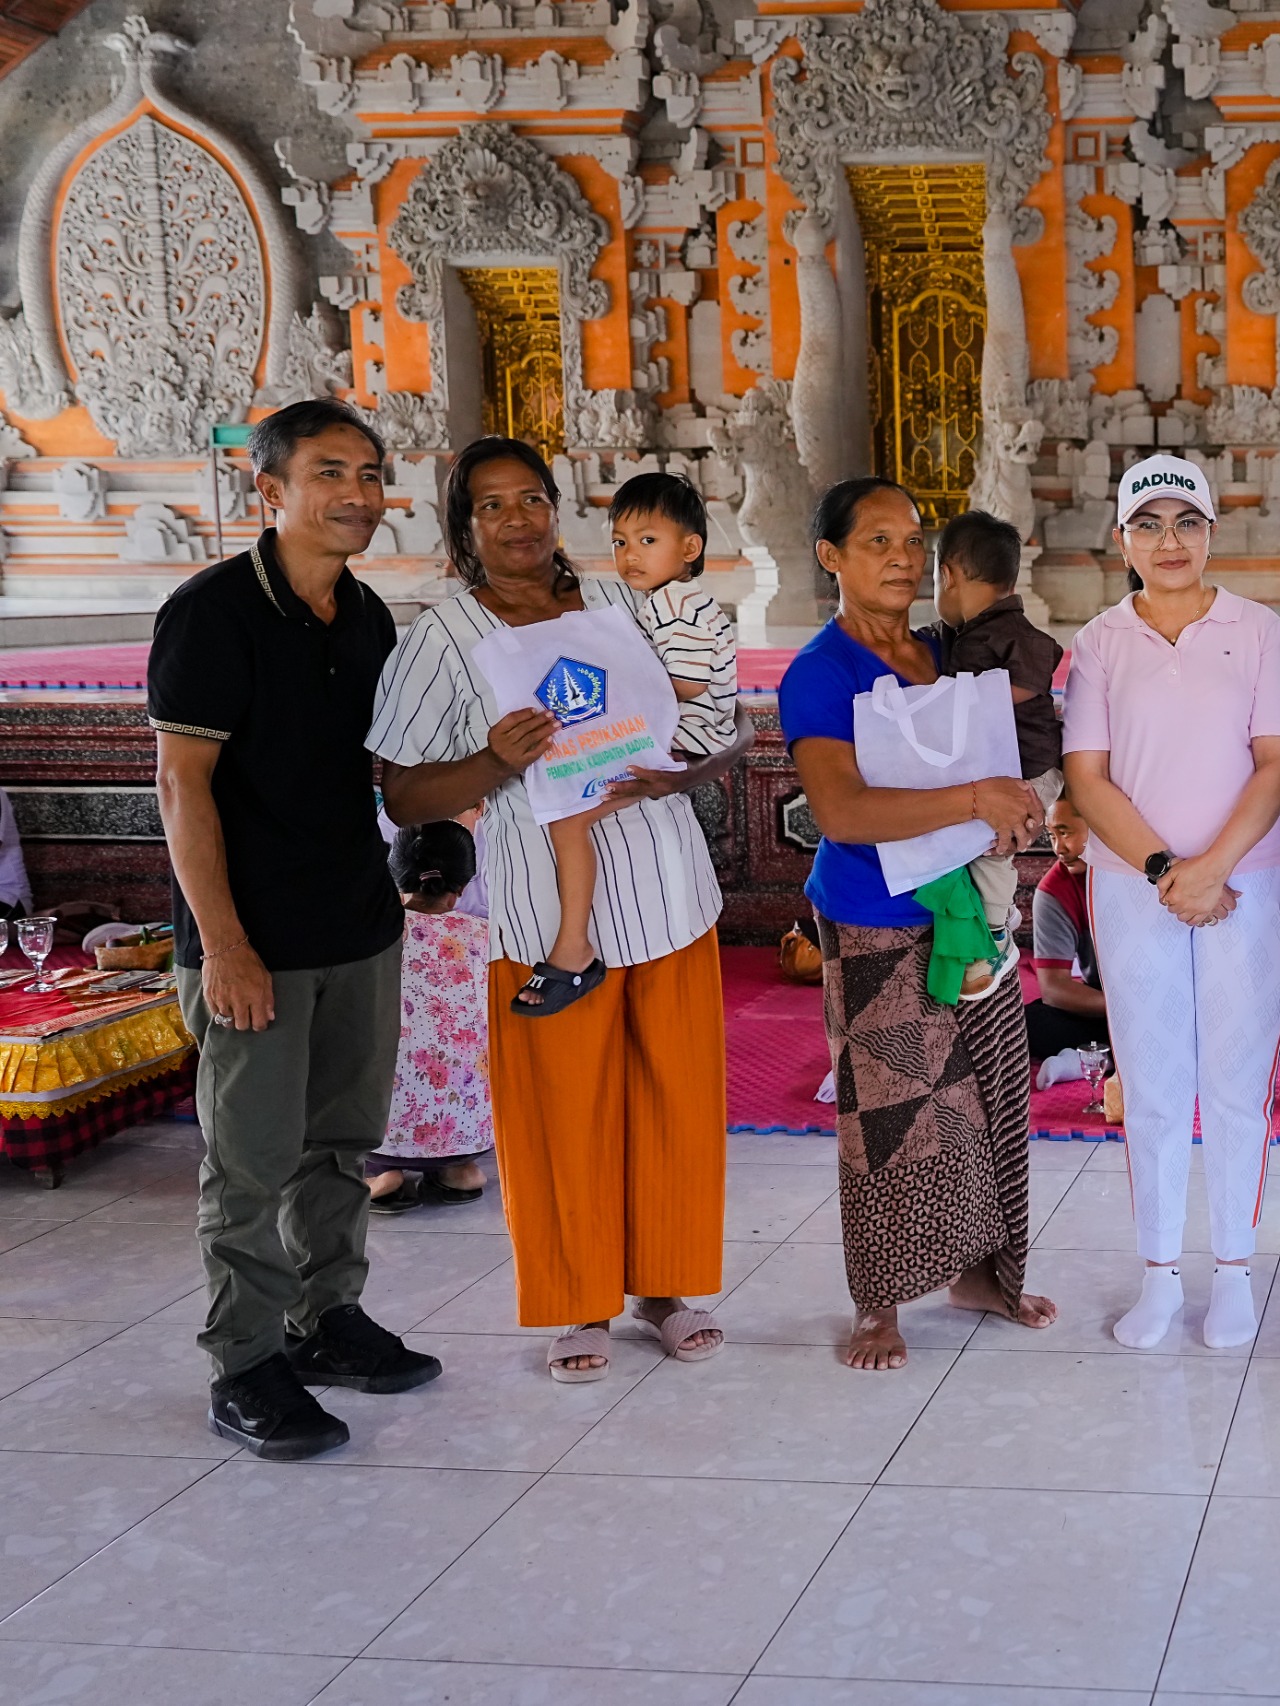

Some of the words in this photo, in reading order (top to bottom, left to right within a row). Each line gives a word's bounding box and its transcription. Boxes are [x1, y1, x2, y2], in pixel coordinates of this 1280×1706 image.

[1132, 472, 1196, 495] BADUNG
[577, 715, 647, 751] PERIKANAN
[625, 735, 655, 756] BADUNG
